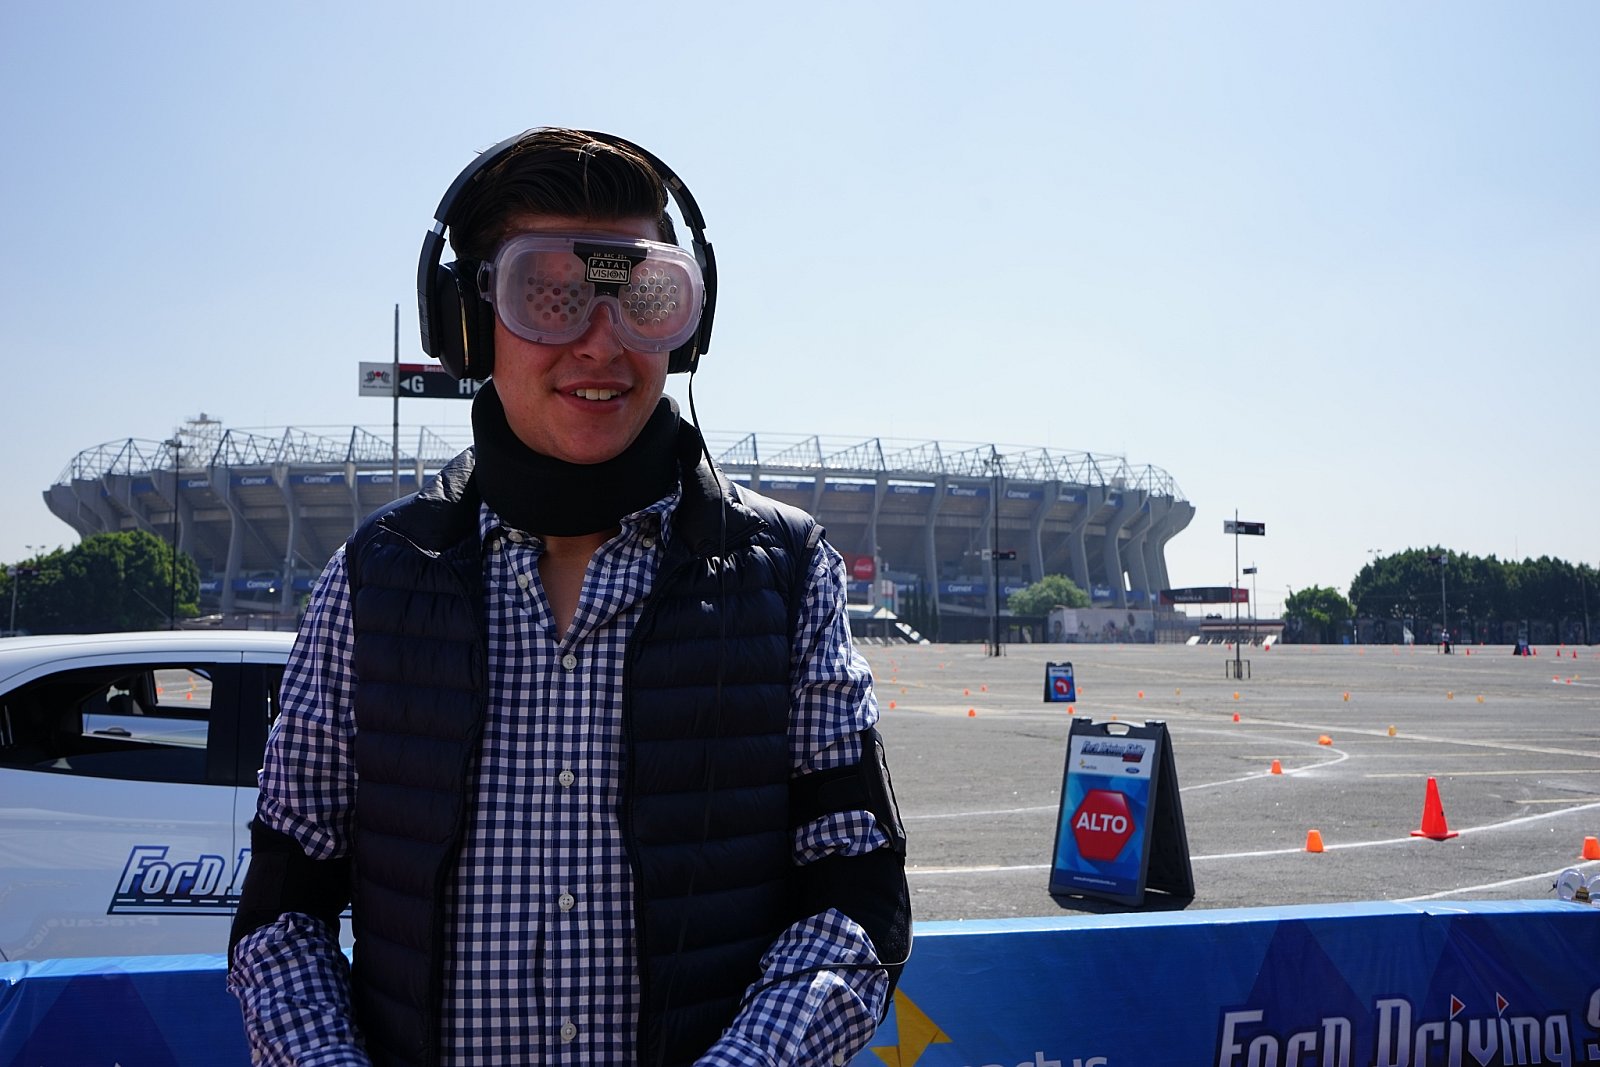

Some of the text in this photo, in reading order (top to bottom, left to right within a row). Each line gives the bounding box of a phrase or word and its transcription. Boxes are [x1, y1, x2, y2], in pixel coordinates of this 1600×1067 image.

[592, 260, 627, 269] FATAL
[591, 269, 626, 279] VISION
[411, 375, 471, 394] G H
[241, 476, 268, 486] Comex
[303, 475, 332, 484] Comex
[952, 487, 978, 497] Comex
[246, 580, 275, 589] Comex
[948, 584, 973, 593] Comex
[1076, 812, 1127, 834] ALTO
[1373, 991, 1573, 1067] Driving
